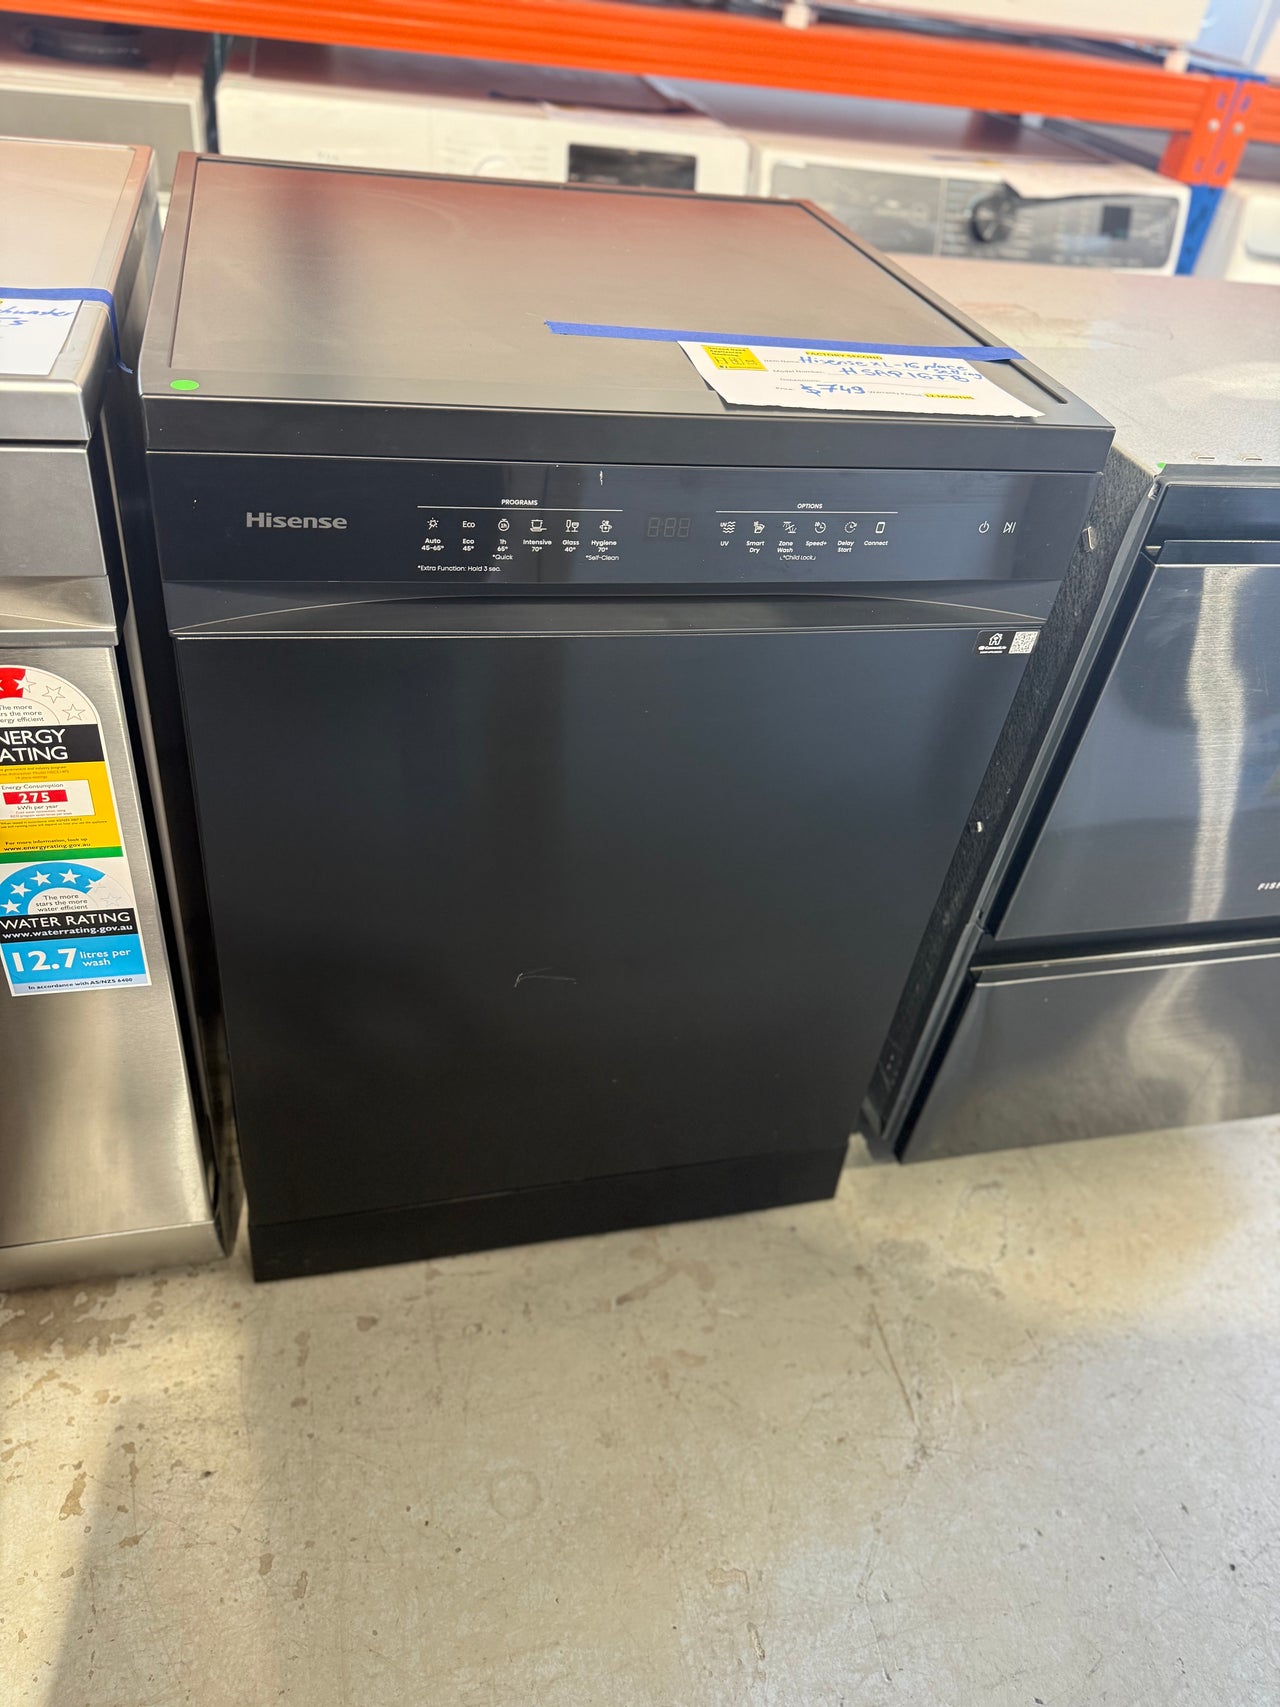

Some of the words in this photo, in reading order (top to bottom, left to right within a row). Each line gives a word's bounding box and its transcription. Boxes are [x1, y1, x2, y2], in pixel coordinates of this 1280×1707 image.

[799, 356, 868, 366] Hisense
[800, 383, 866, 397] $749
[246, 512, 348, 529] Hisense
[462, 520, 476, 528] Eco
[805, 540, 828, 548] Speed+
[18, 791, 51, 804] 275
[4, 843, 91, 852] www.energyrating.gov.au
[0, 916, 61, 930] WATER
[65, 911, 131, 926] RATING
[2, 924, 133, 939] www.waterrating.gov.au
[11, 947, 77, 973] 12.7
[80, 950, 109, 960] litres
[112, 949, 131, 959] per
[82, 958, 111, 967] wash
[36, 982, 74, 990] accordance
